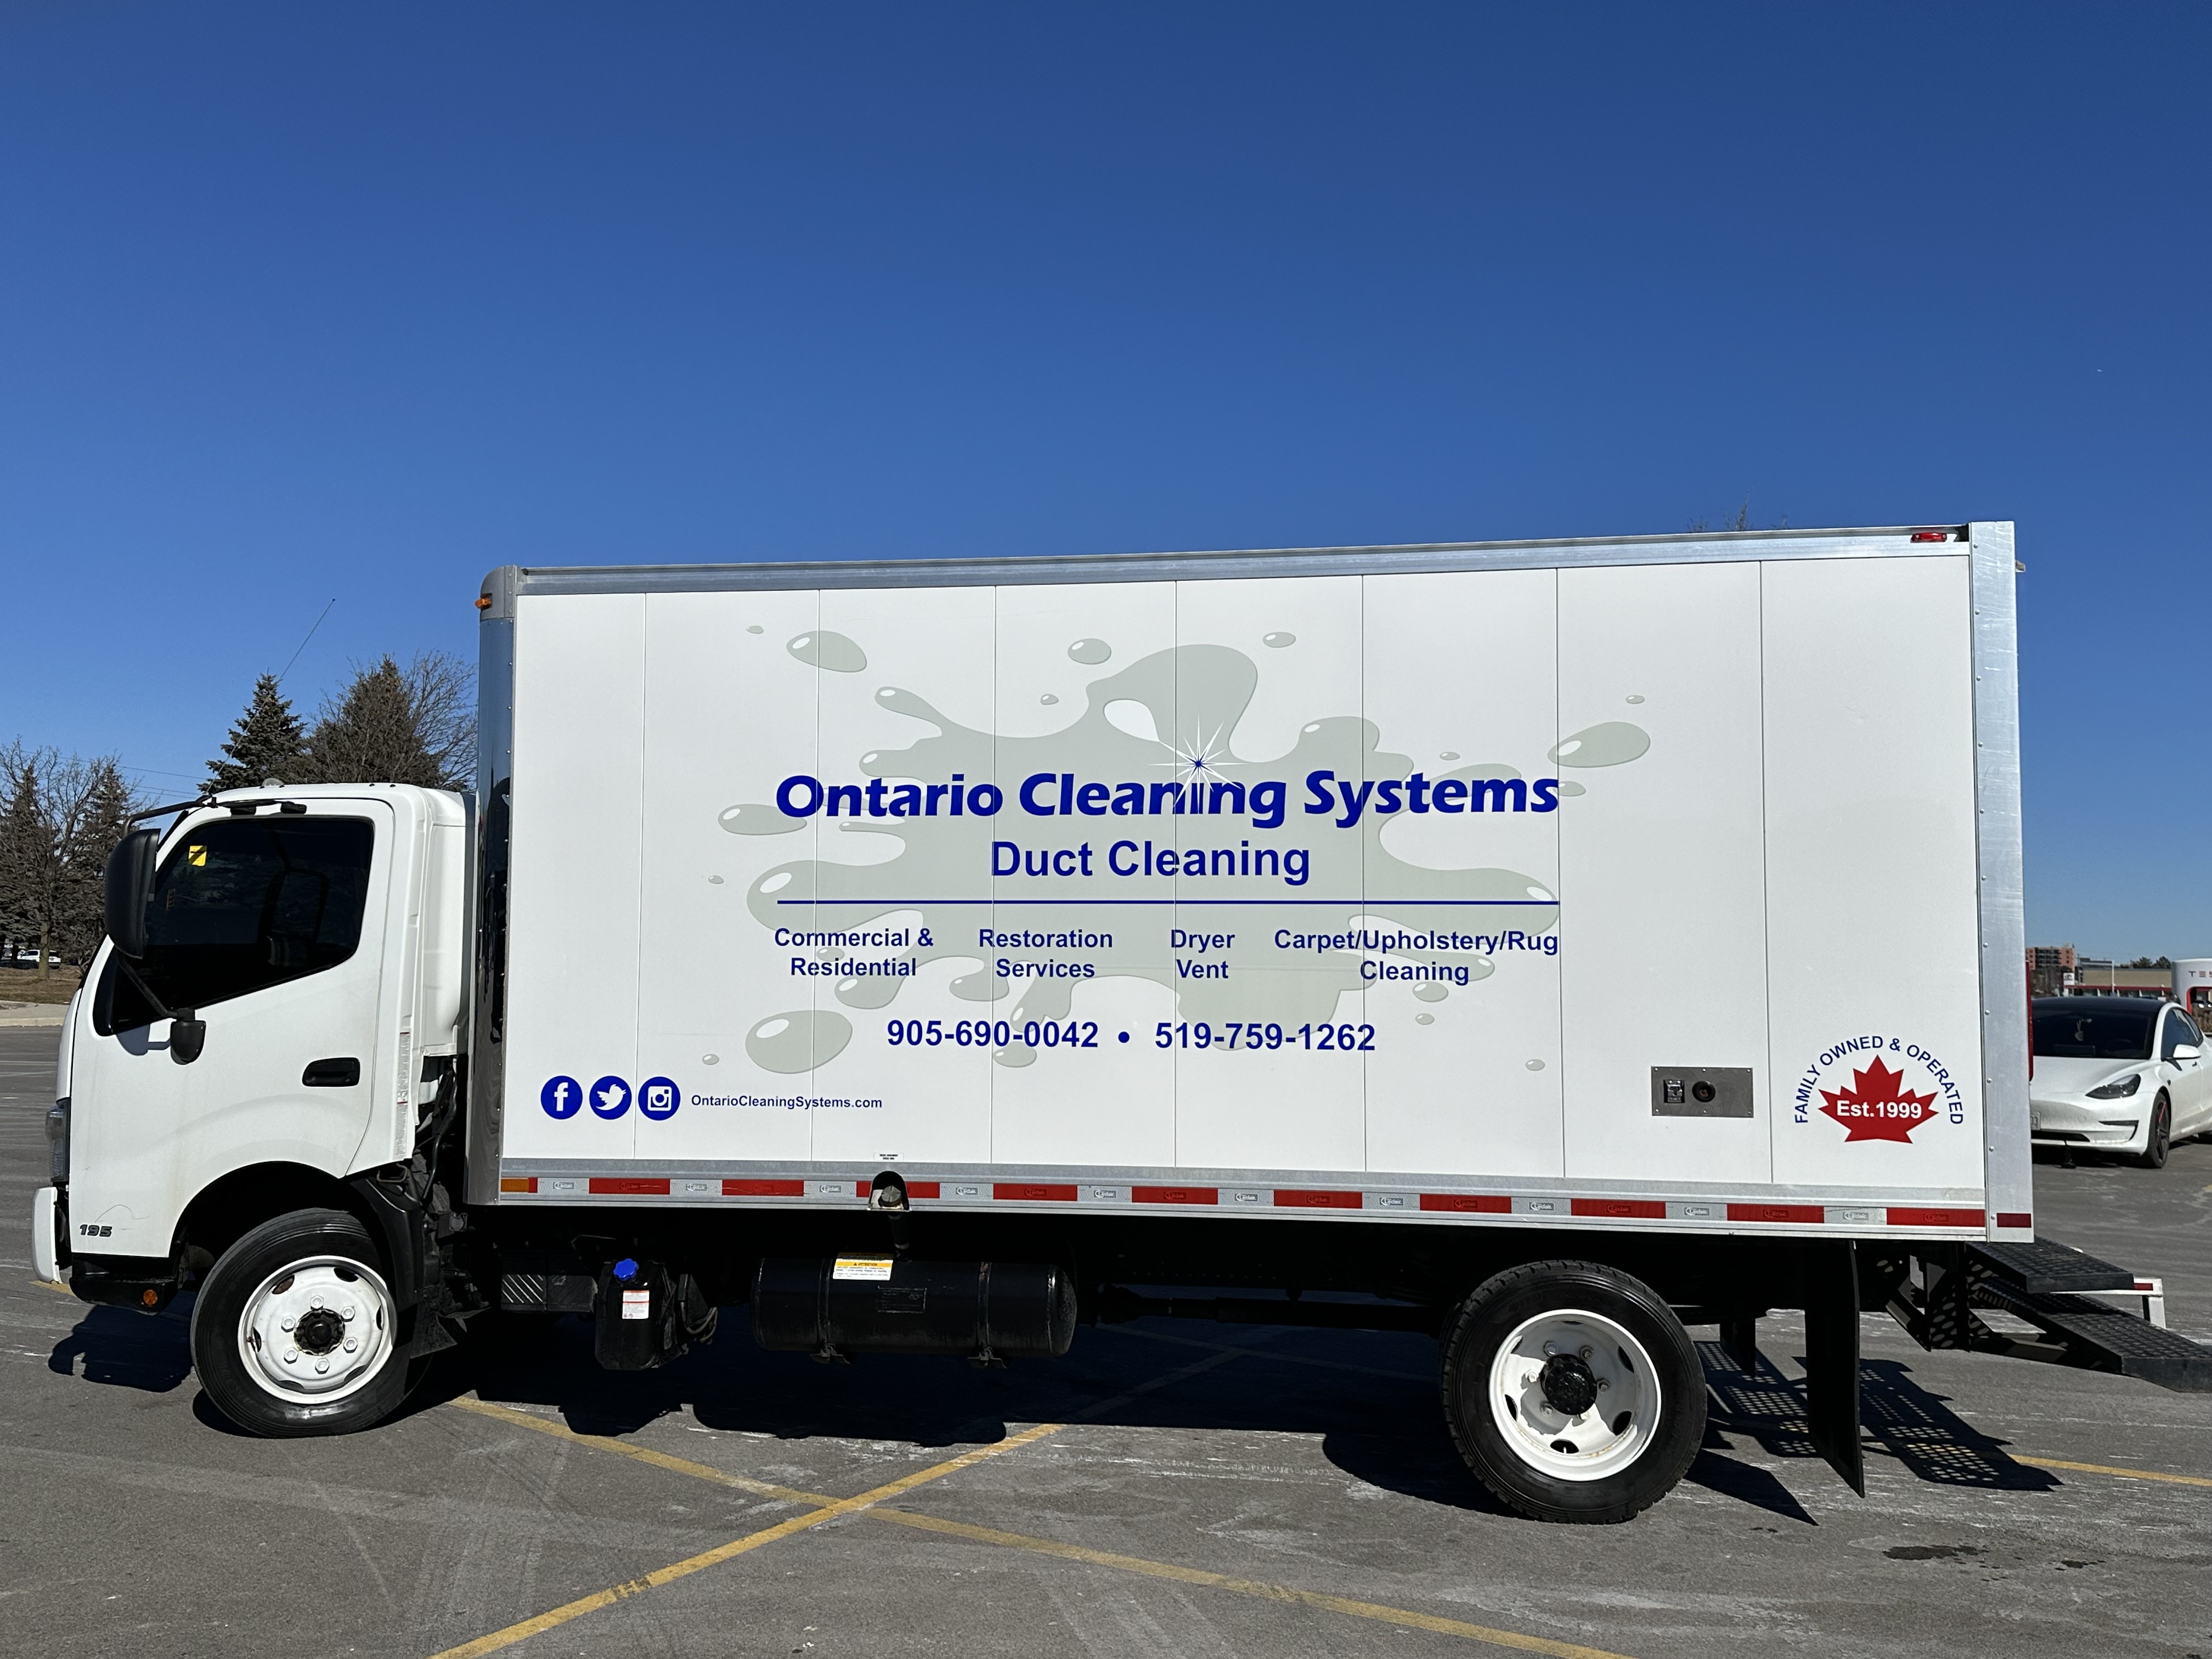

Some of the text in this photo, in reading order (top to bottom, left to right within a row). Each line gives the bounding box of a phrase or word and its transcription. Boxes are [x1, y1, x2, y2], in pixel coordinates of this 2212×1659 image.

[776, 770, 1559, 829] Ontario Cleaning Systems
[991, 840, 1310, 886] Duct Cleaning
[775, 928, 934, 948] Commercial &
[979, 928, 1113, 948] Restoration
[1171, 929, 1235, 953] Dryer
[1274, 928, 1559, 956] Carpet/Upholstery/Rug
[791, 957, 916, 977] Residential
[996, 958, 1095, 978] Services
[1176, 960, 1228, 979] Vent
[1360, 960, 1469, 986] Cleaning
[887, 1019, 1375, 1051] 905-690-0042 519-759-1262
[1795, 1036, 1964, 1125] FAMILY OWNED & OPERATED
[691, 1094, 882, 1110] OntarioCleaningSystems.com
[1836, 1100, 1922, 1120] Est.1999
[80, 1224, 112, 1237] 195
